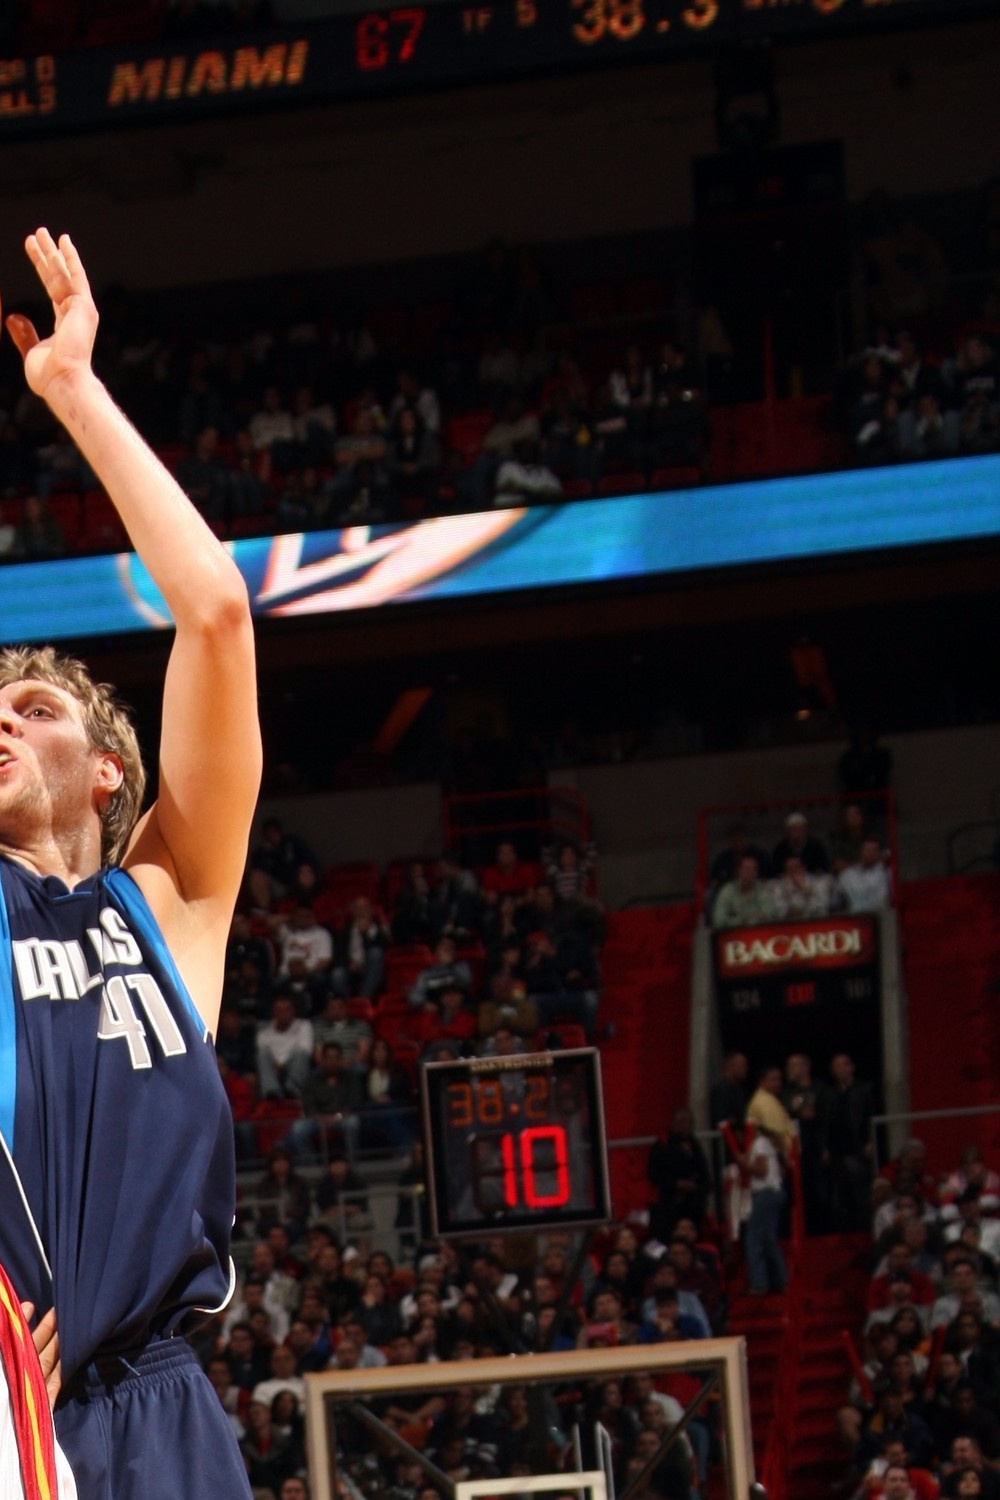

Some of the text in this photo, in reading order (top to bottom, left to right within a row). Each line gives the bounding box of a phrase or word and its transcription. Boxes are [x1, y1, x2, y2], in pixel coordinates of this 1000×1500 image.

[356, 8, 426, 70] 67
[107, 39, 309, 106] MIAMI
[725, 928, 861, 968] BACARDI
[97, 973, 188, 1070] 41
[449, 1075, 549, 1127] 38.2
[501, 1124, 571, 1209] 10
